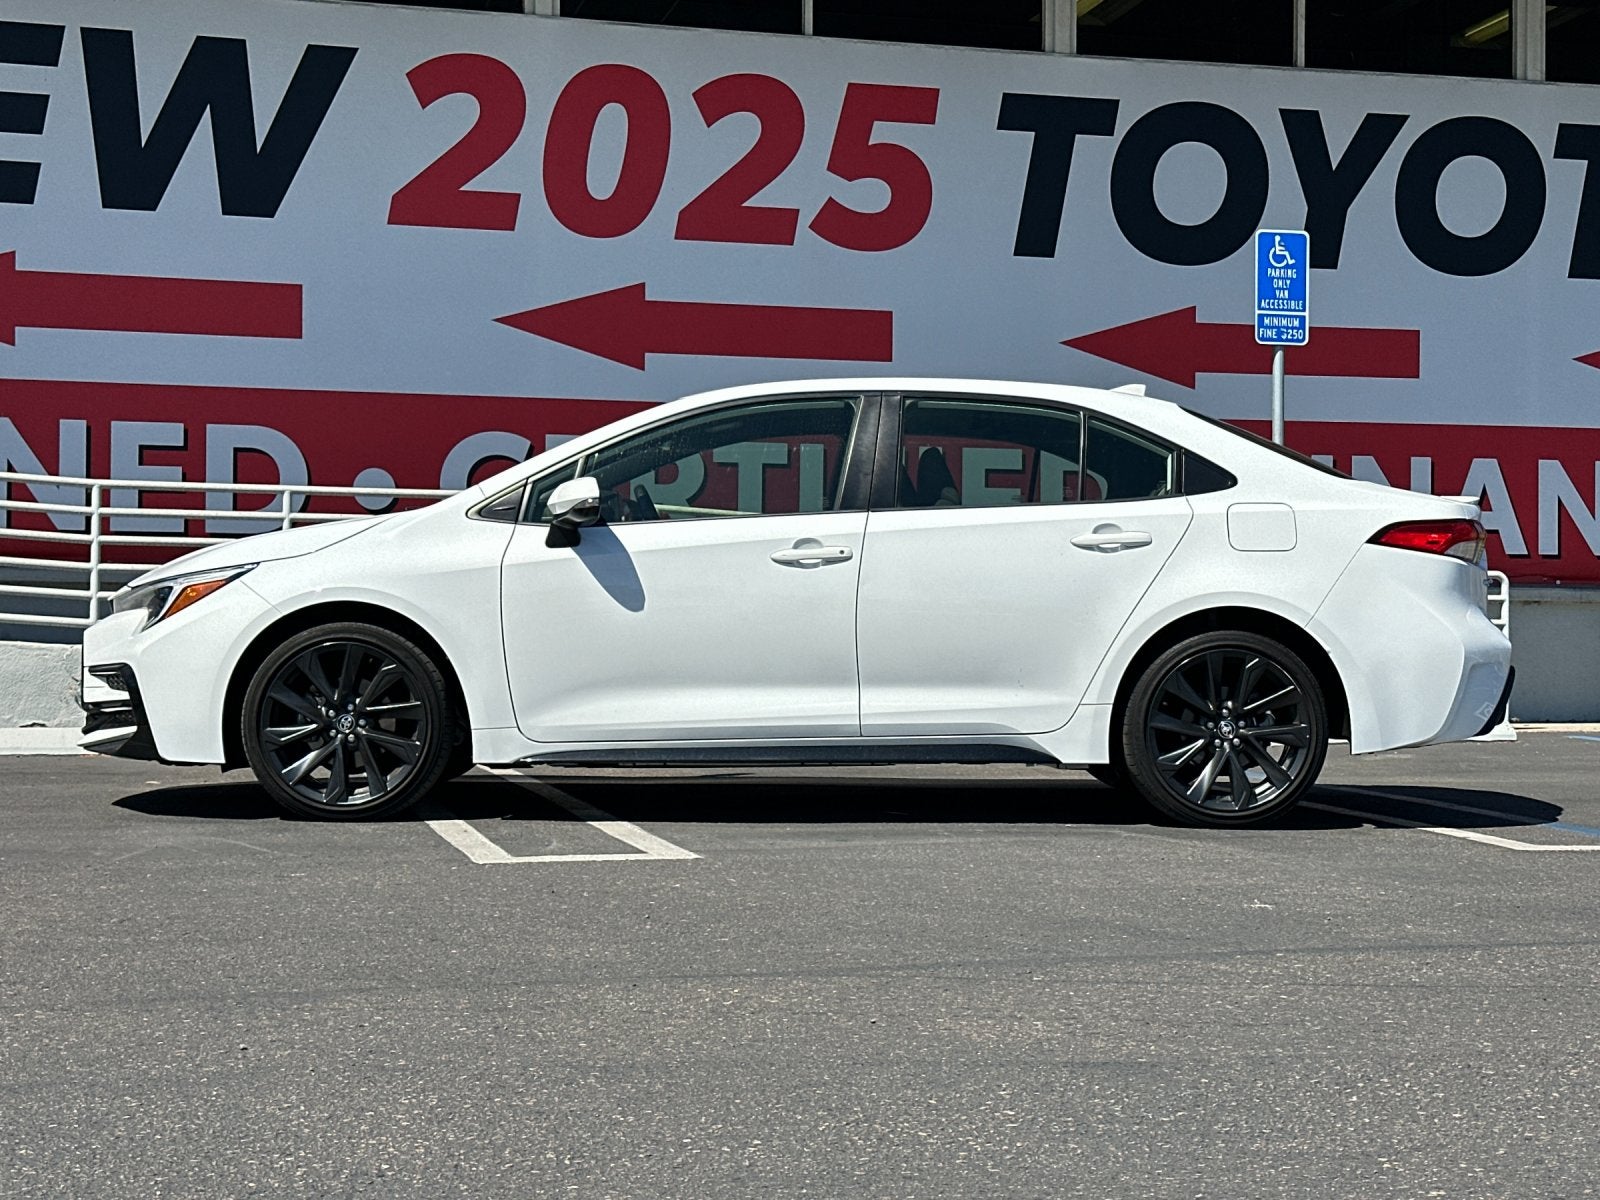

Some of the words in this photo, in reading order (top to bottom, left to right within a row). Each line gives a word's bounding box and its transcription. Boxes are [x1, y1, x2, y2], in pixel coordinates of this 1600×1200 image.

[389, 54, 938, 251] 2025
[1267, 267, 1297, 278] PARKING
[1272, 278, 1291, 288] ONLY
[1275, 289, 1289, 298] VAN
[1260, 299, 1303, 310] ACCESSIBLE
[1263, 316, 1300, 327] MINIMUM
[1259, 328, 1278, 339] FINE
